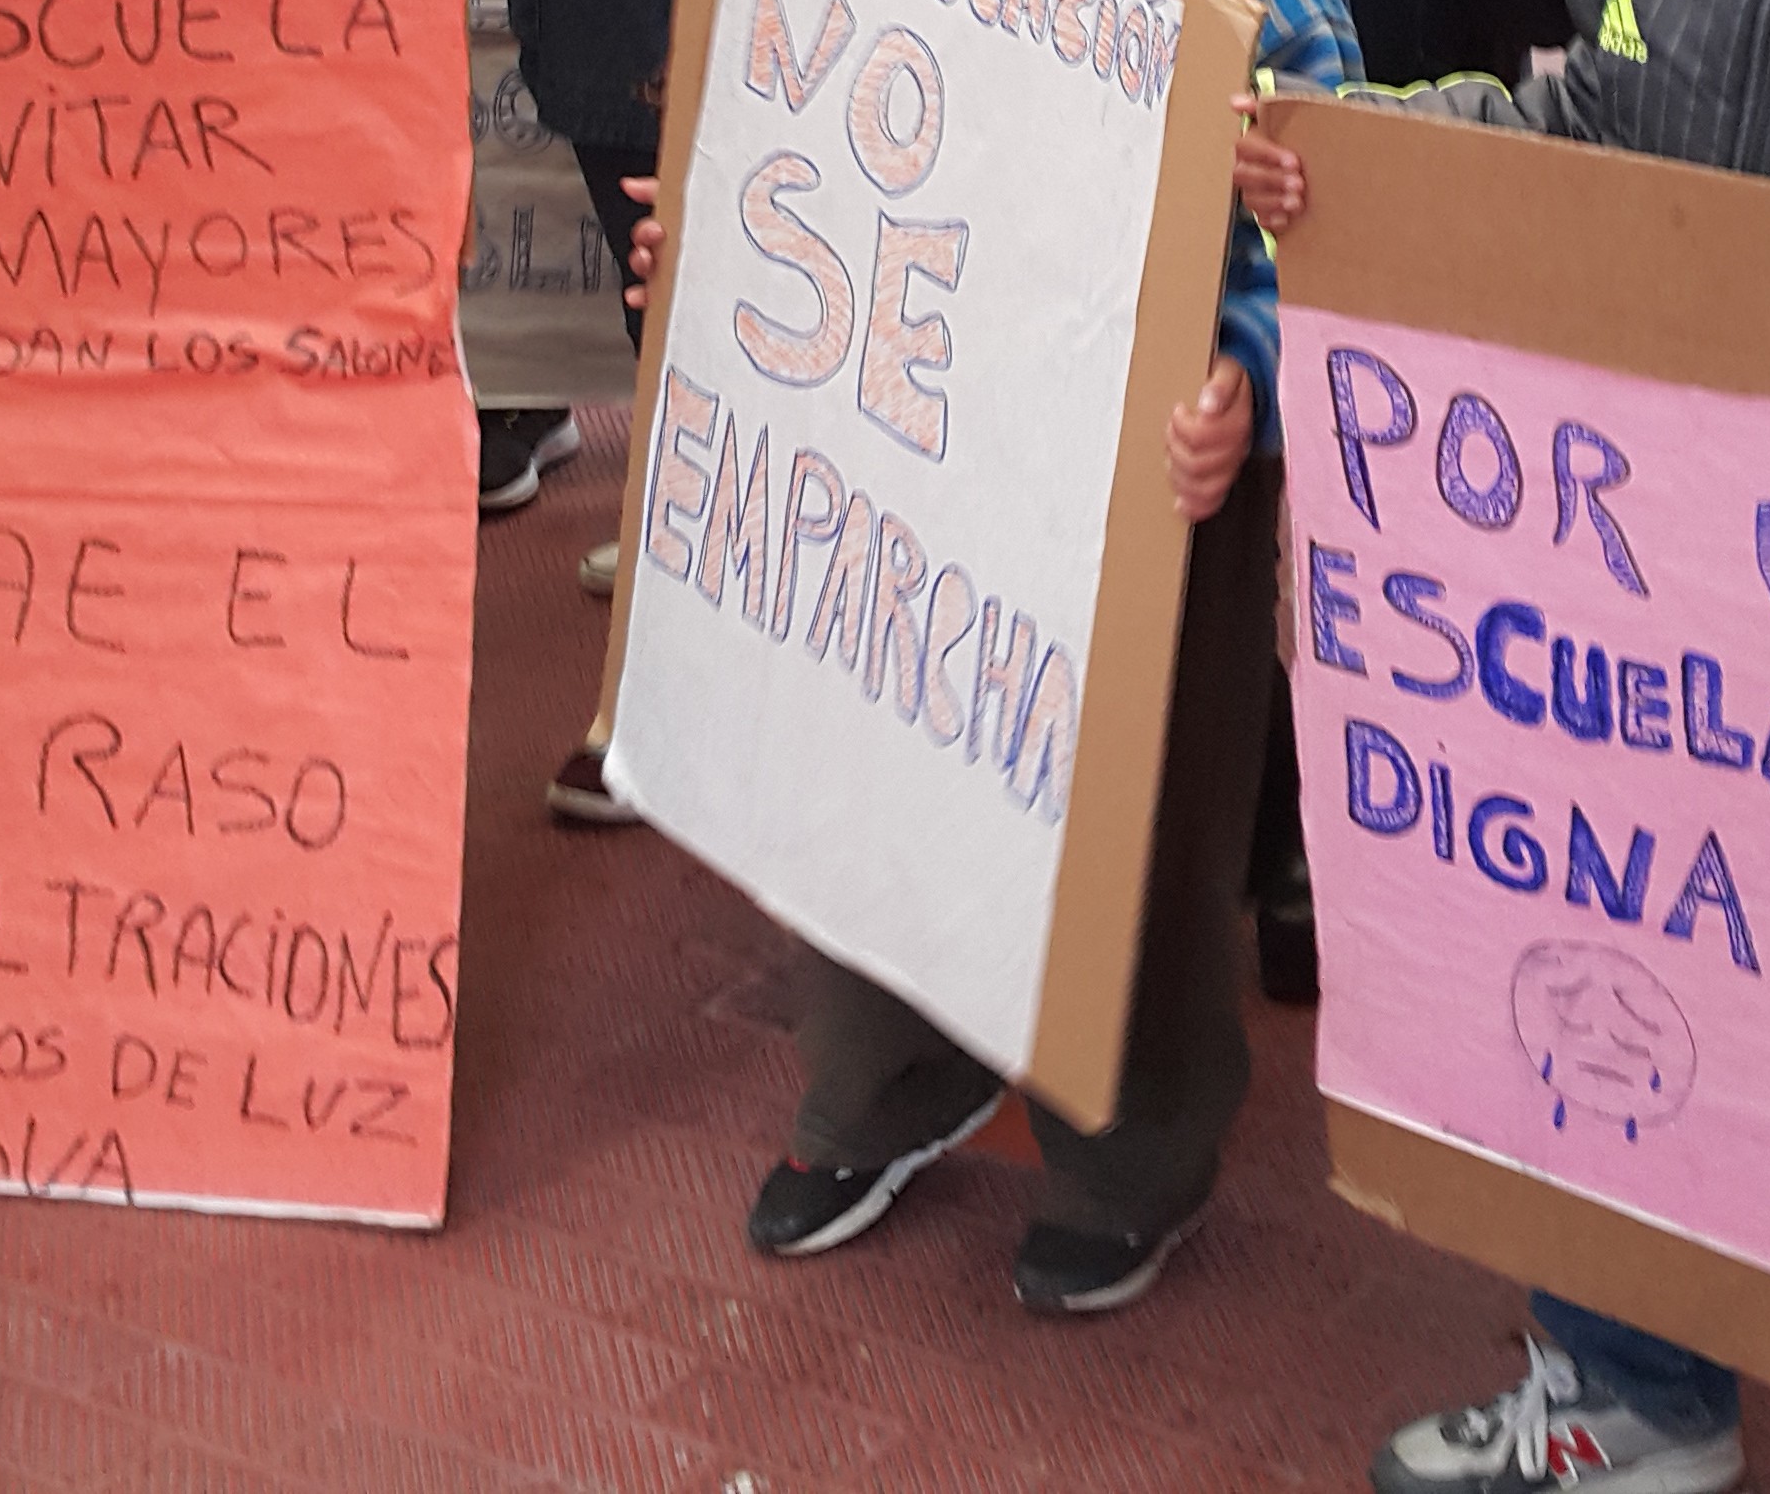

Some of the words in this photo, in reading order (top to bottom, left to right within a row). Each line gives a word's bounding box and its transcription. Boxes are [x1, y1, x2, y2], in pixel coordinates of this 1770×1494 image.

[149, 327, 259, 376] LOS
[734, 149, 971, 464] SE
[1325, 347, 1651, 599] POR
[230, 548, 411, 661] EL
[644, 364, 1081, 828] EMPARCHA
[37, 711, 347, 850] RASO
[109, 1035, 210, 1108] DE
[238, 1055, 418, 1149] LUZ
